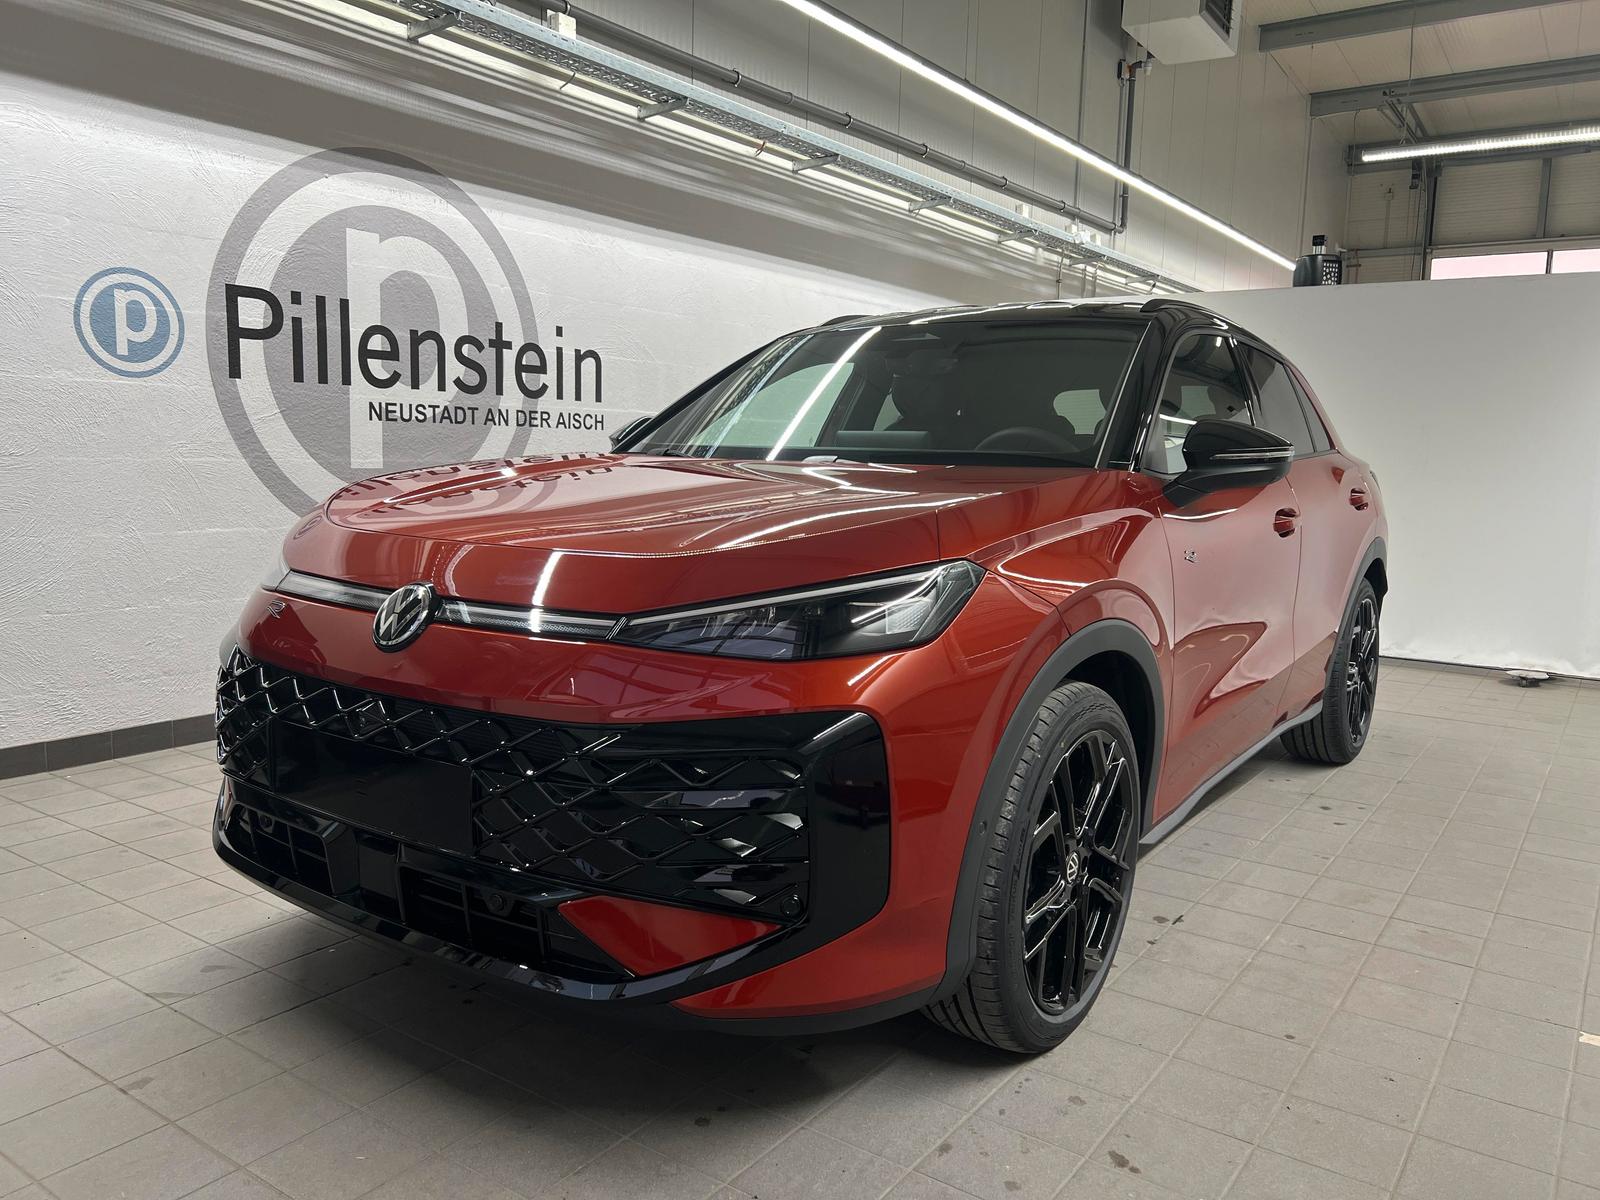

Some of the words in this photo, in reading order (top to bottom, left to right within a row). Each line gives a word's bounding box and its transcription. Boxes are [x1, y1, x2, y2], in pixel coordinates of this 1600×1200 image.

[114, 288, 158, 355] p
[224, 283, 603, 403] Pillenstein
[368, 401, 479, 425] NEUSTADT
[483, 407, 509, 427] AN
[515, 409, 551, 428] DER
[555, 412, 604, 431] AISCH
